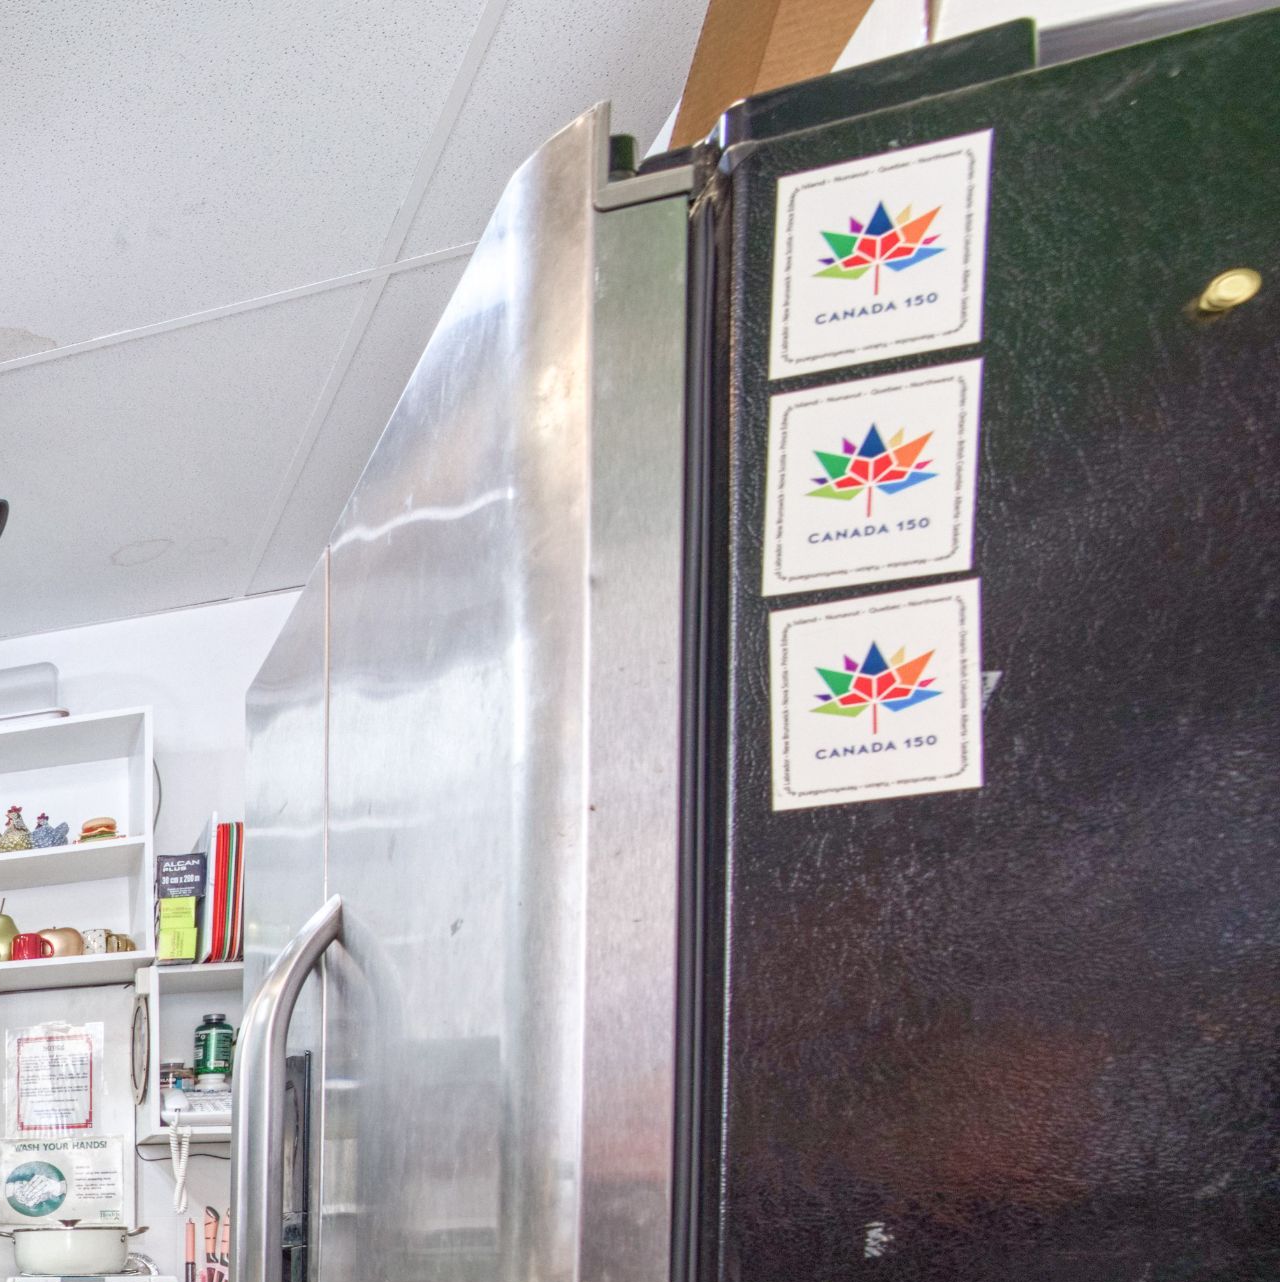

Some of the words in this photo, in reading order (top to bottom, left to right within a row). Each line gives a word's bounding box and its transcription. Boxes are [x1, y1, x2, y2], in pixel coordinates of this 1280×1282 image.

[814, 301, 897, 325] CANADA
[905, 292, 939, 308] 150
[808, 524, 890, 544] CANADA
[896, 517, 930, 532] 150
[815, 740, 897, 760] CANADA
[905, 735, 938, 749] 150
[163, 859, 200, 868] ALCAN
[15, 1143, 39, 1152] WASH
[43, 1142, 69, 1151] YOUR
[72, 1141, 107, 1149] HANDS!
